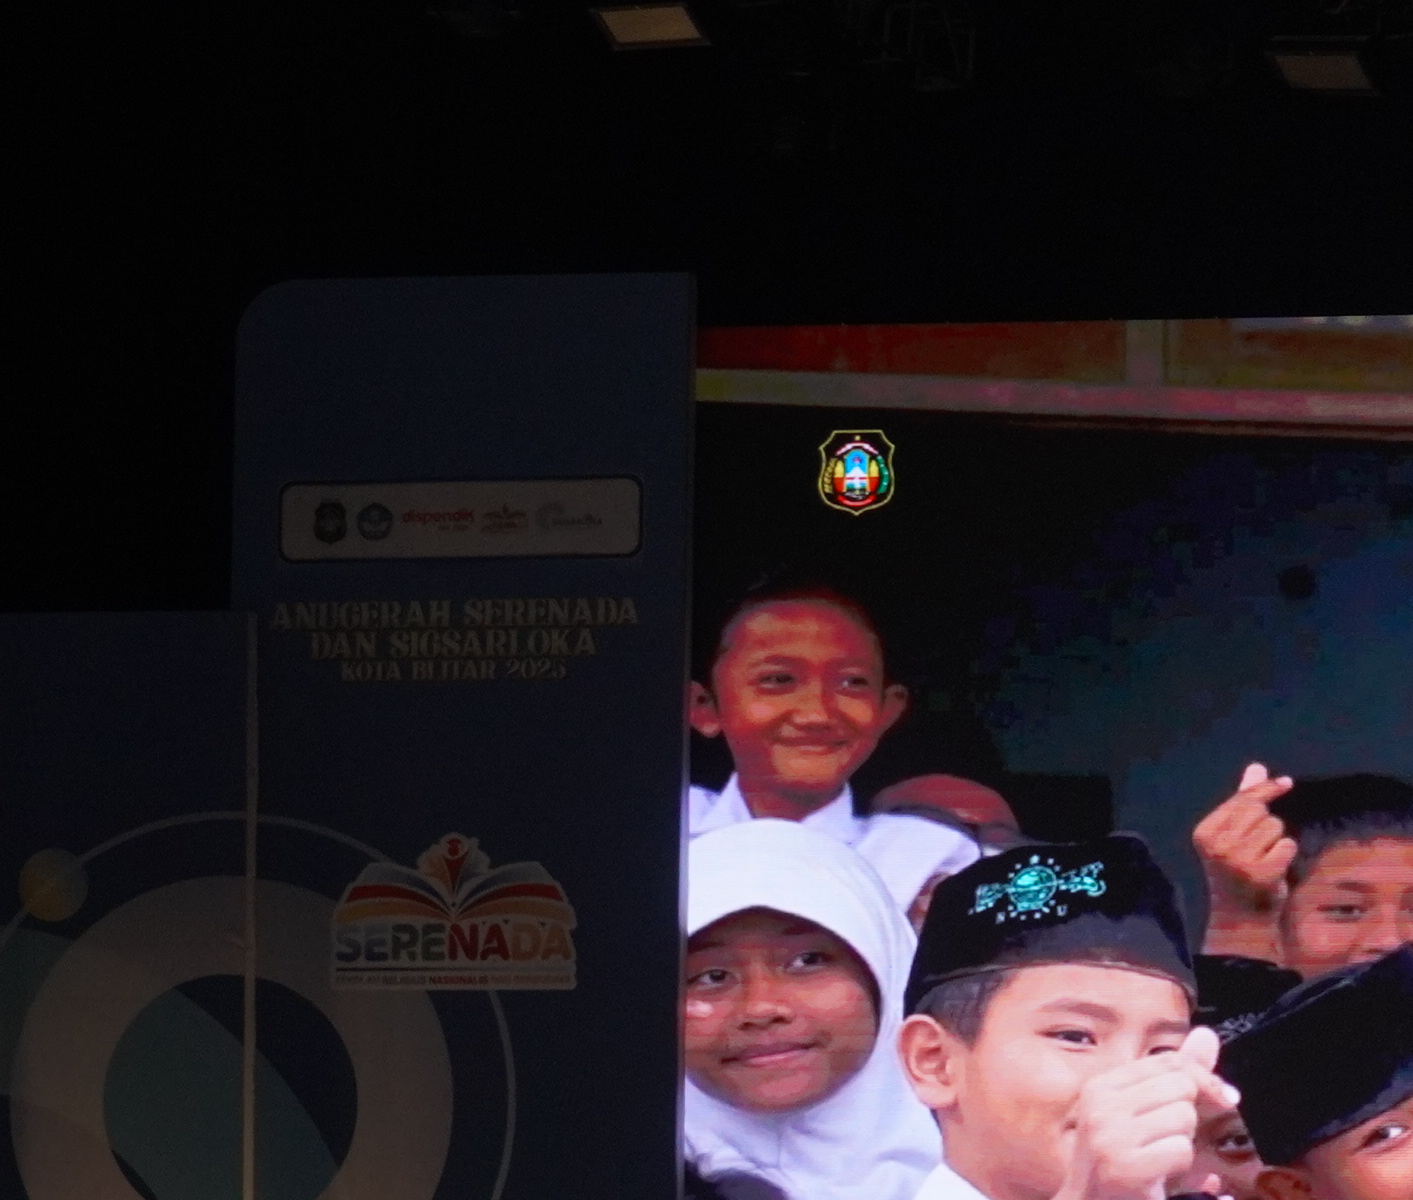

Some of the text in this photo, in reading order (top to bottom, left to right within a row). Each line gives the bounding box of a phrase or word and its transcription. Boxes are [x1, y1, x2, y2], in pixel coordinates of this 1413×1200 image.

[271, 597, 640, 629] ANUGERAH SERENADA
[310, 627, 598, 659] DAN SIGSARLOKA
[341, 658, 568, 682] KOTA BLITAR 2025
[336, 922, 571, 962] SERENADA
